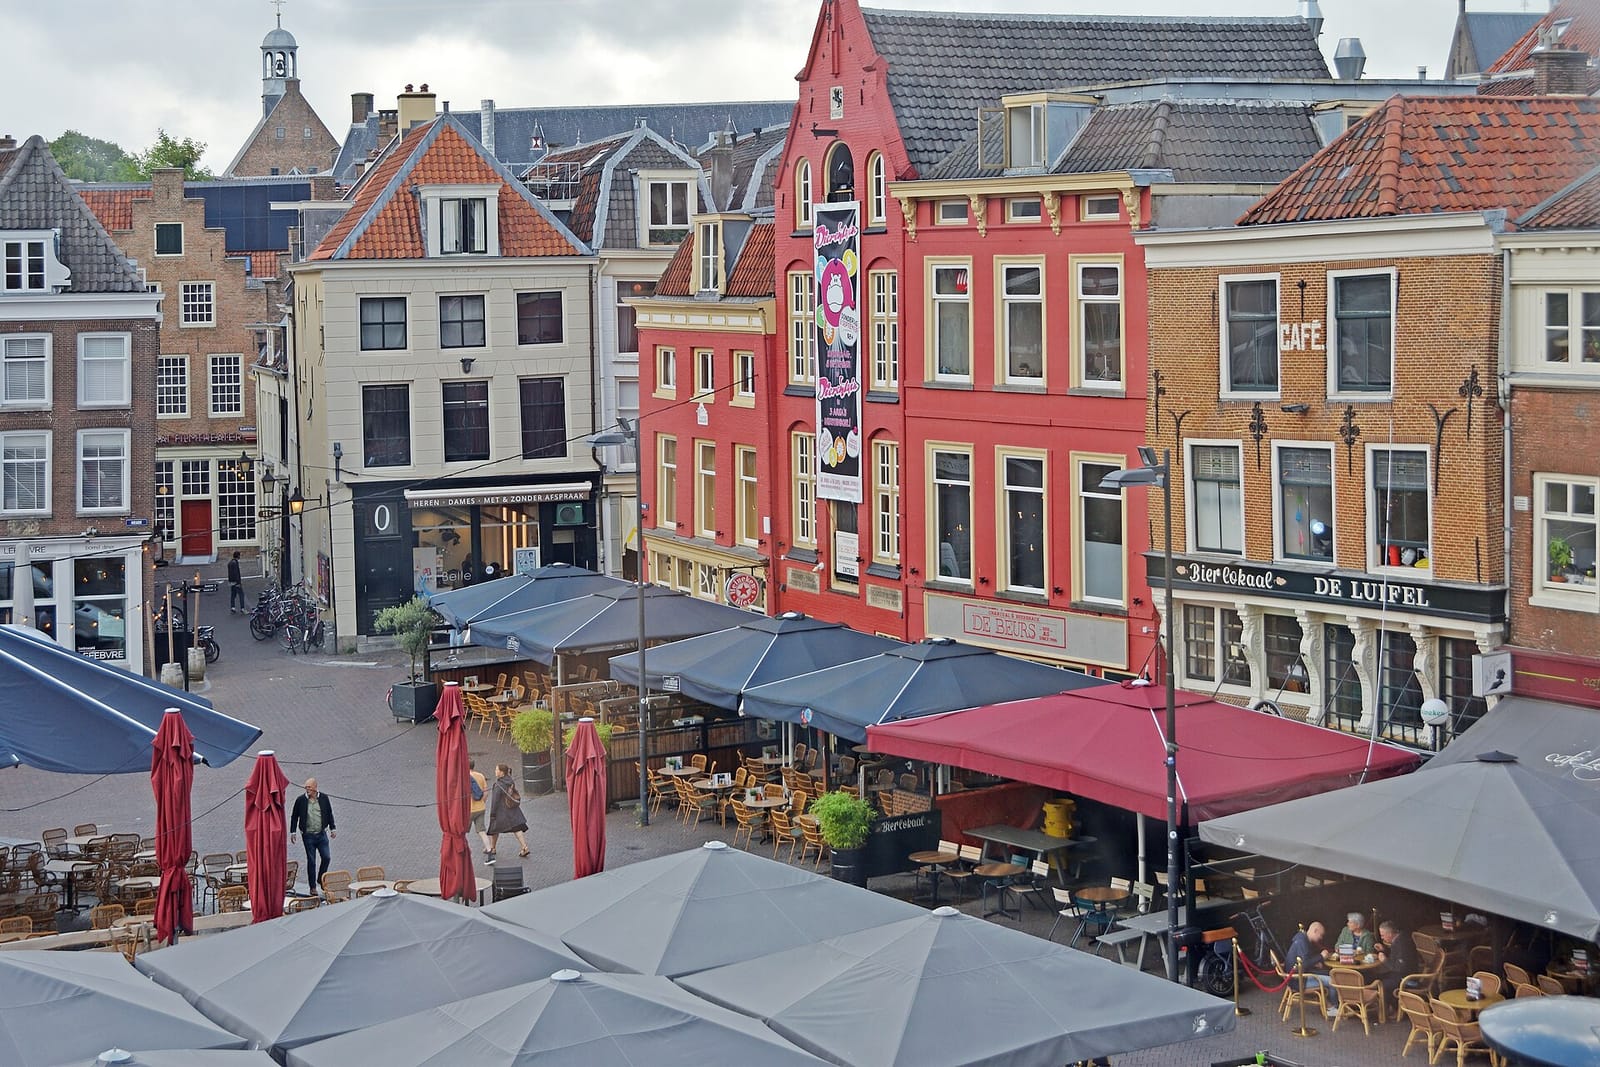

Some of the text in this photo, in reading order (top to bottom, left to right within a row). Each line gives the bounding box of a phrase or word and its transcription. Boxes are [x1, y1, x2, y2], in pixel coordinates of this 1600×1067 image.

[413, 499, 440, 507] HEREN
[448, 497, 475, 506] DAMES
[483, 496, 500, 504] MET
[510, 494, 543, 503] ZONDER
[545, 492, 584, 501] AFSPRAAK
[1314, 577, 1342, 597] DE
[1350, 580, 1429, 607] LUIFEL
[972, 614, 991, 632] DE
[995, 618, 1036, 639] BEURS
